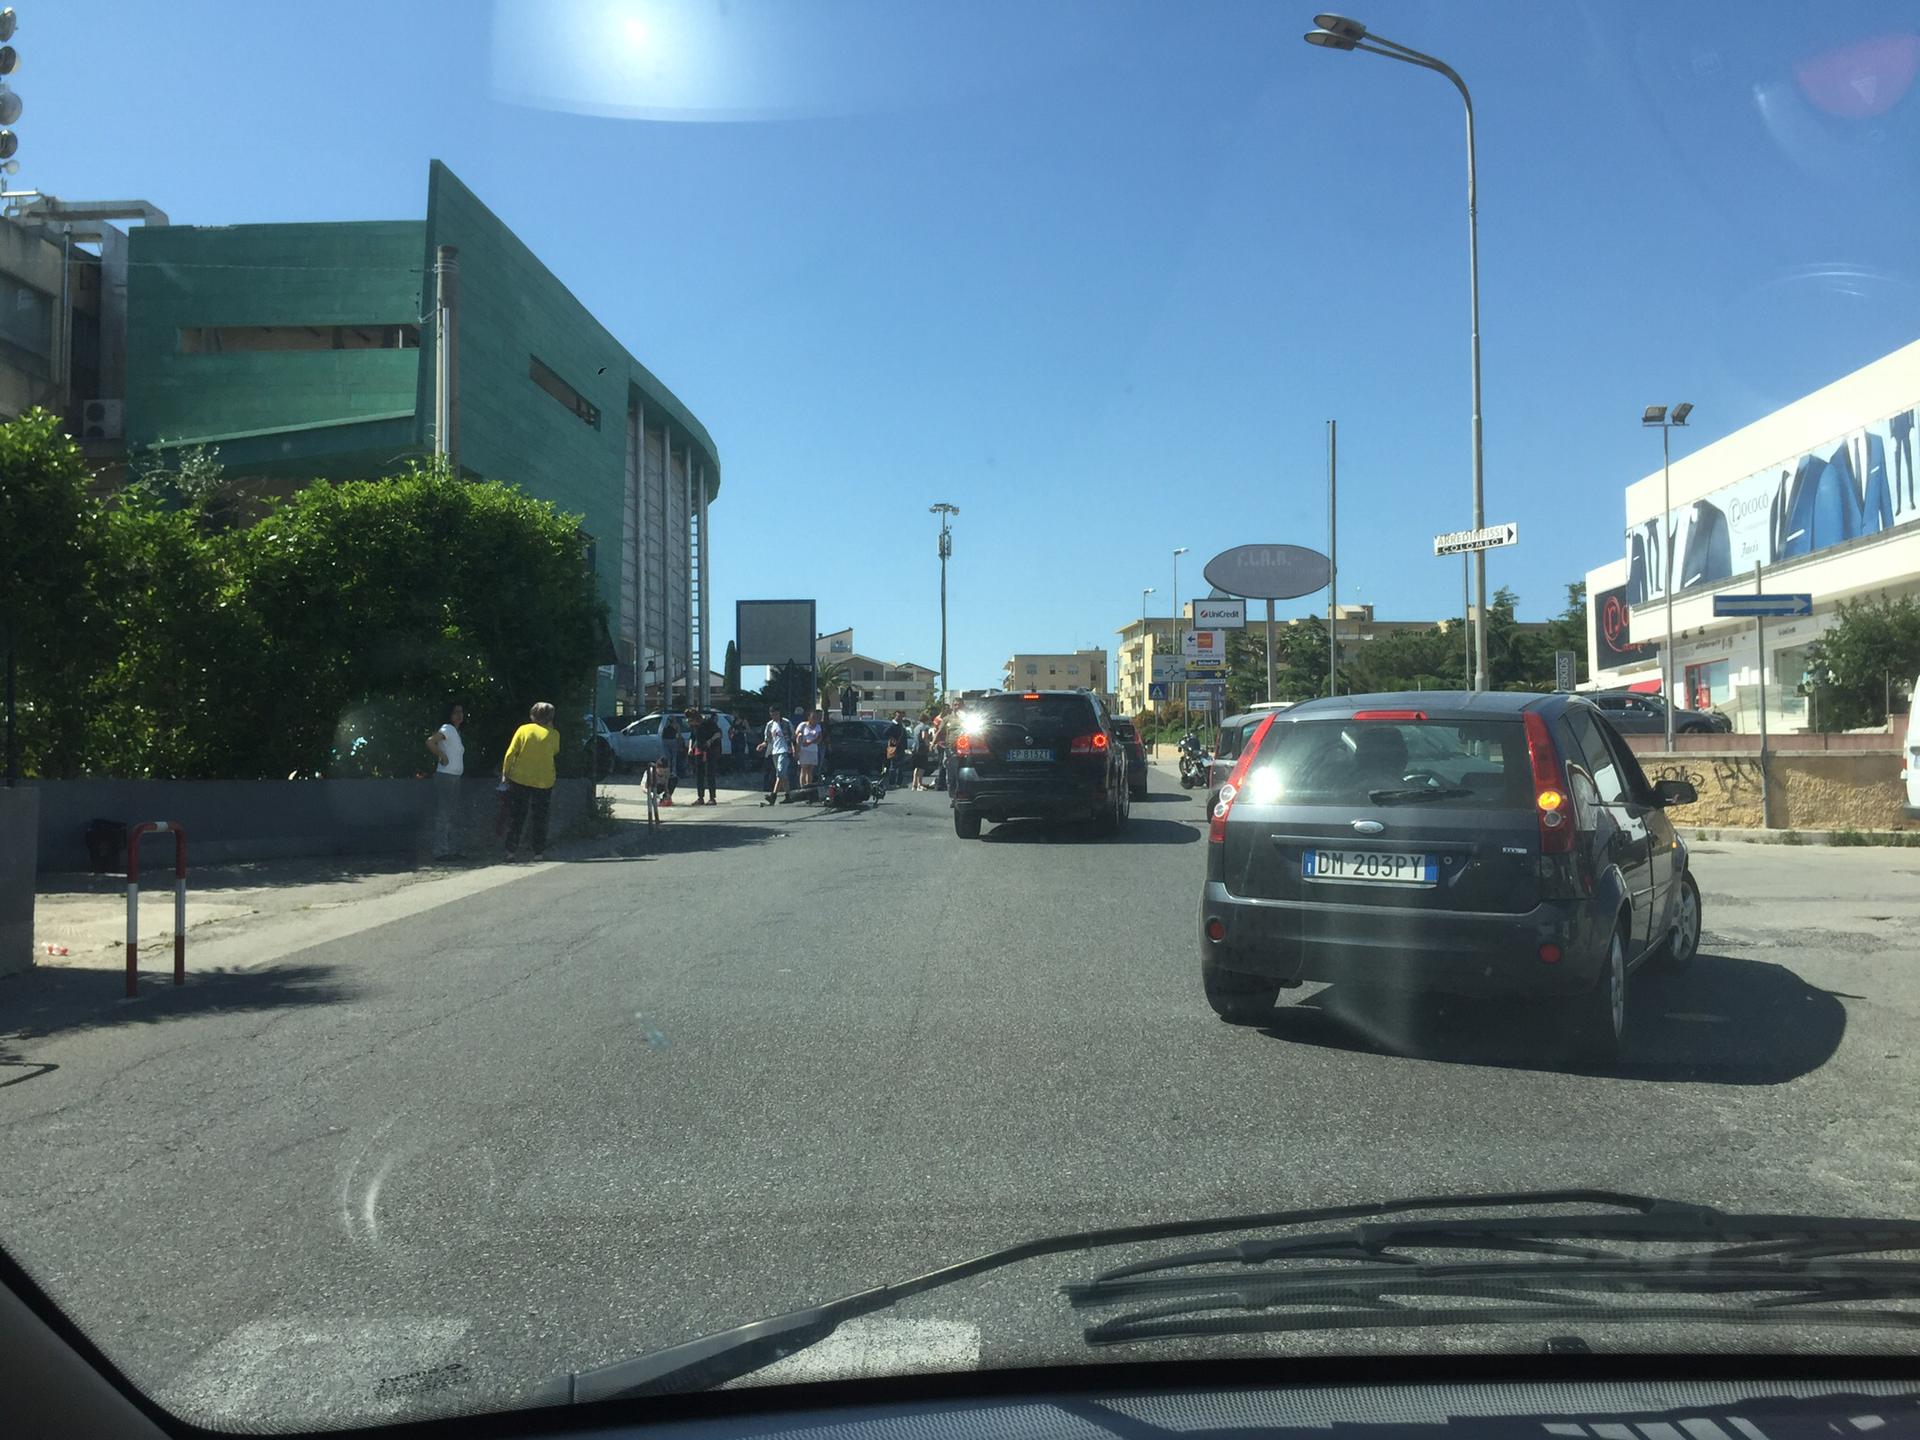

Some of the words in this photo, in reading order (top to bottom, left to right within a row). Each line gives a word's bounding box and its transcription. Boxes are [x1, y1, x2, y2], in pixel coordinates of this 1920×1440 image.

[1442, 539, 1500, 552] COLOMBO
[1208, 610, 1239, 618] UniCredit
[1317, 851, 1344, 875] DM
[1353, 854, 1422, 879] 203PY
